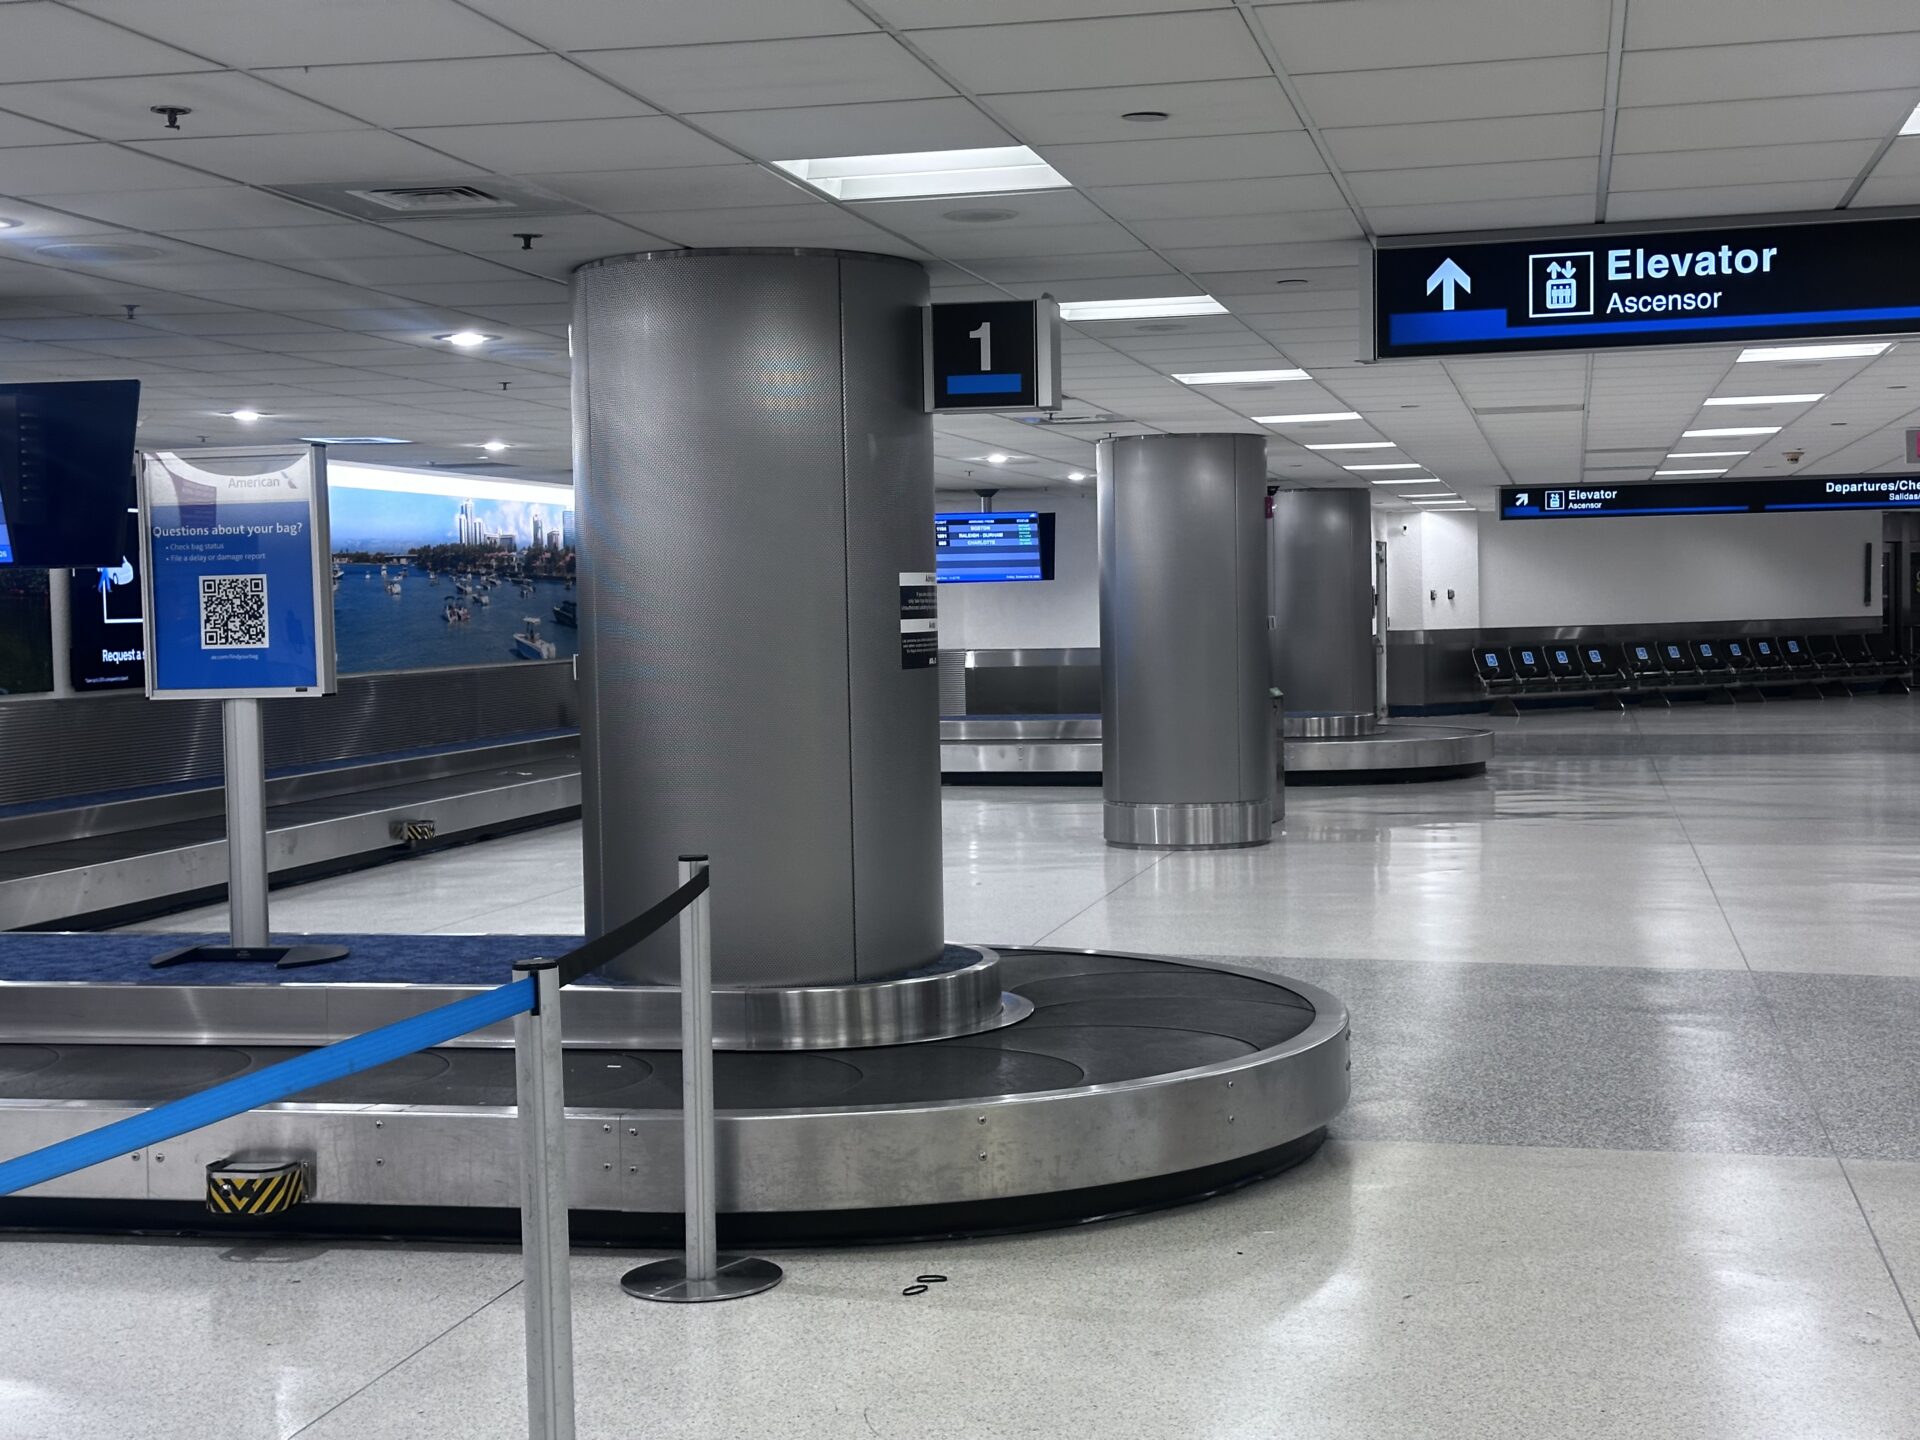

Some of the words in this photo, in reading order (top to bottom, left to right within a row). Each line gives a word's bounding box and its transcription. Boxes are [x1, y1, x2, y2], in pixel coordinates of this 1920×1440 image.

[1607, 245, 1777, 281] Elevator
[1606, 291, 1722, 314] Ascensor
[969, 322, 991, 371] 1
[228, 477, 280, 489] American
[1568, 489, 1617, 500] Elevator
[153, 525, 209, 538] Questions
[212, 524, 245, 535] about
[247, 524, 273, 537] your
[276, 522, 303, 536] bag?
[170, 543, 190, 551] Check
[191, 543, 203, 552] bag
[171, 554, 182, 562] File
[189, 554, 207, 563] delay
[216, 553, 244, 562] damage
[245, 553, 266, 562] report
[102, 648, 136, 665] Request
[136, 650, 142, 660] a
